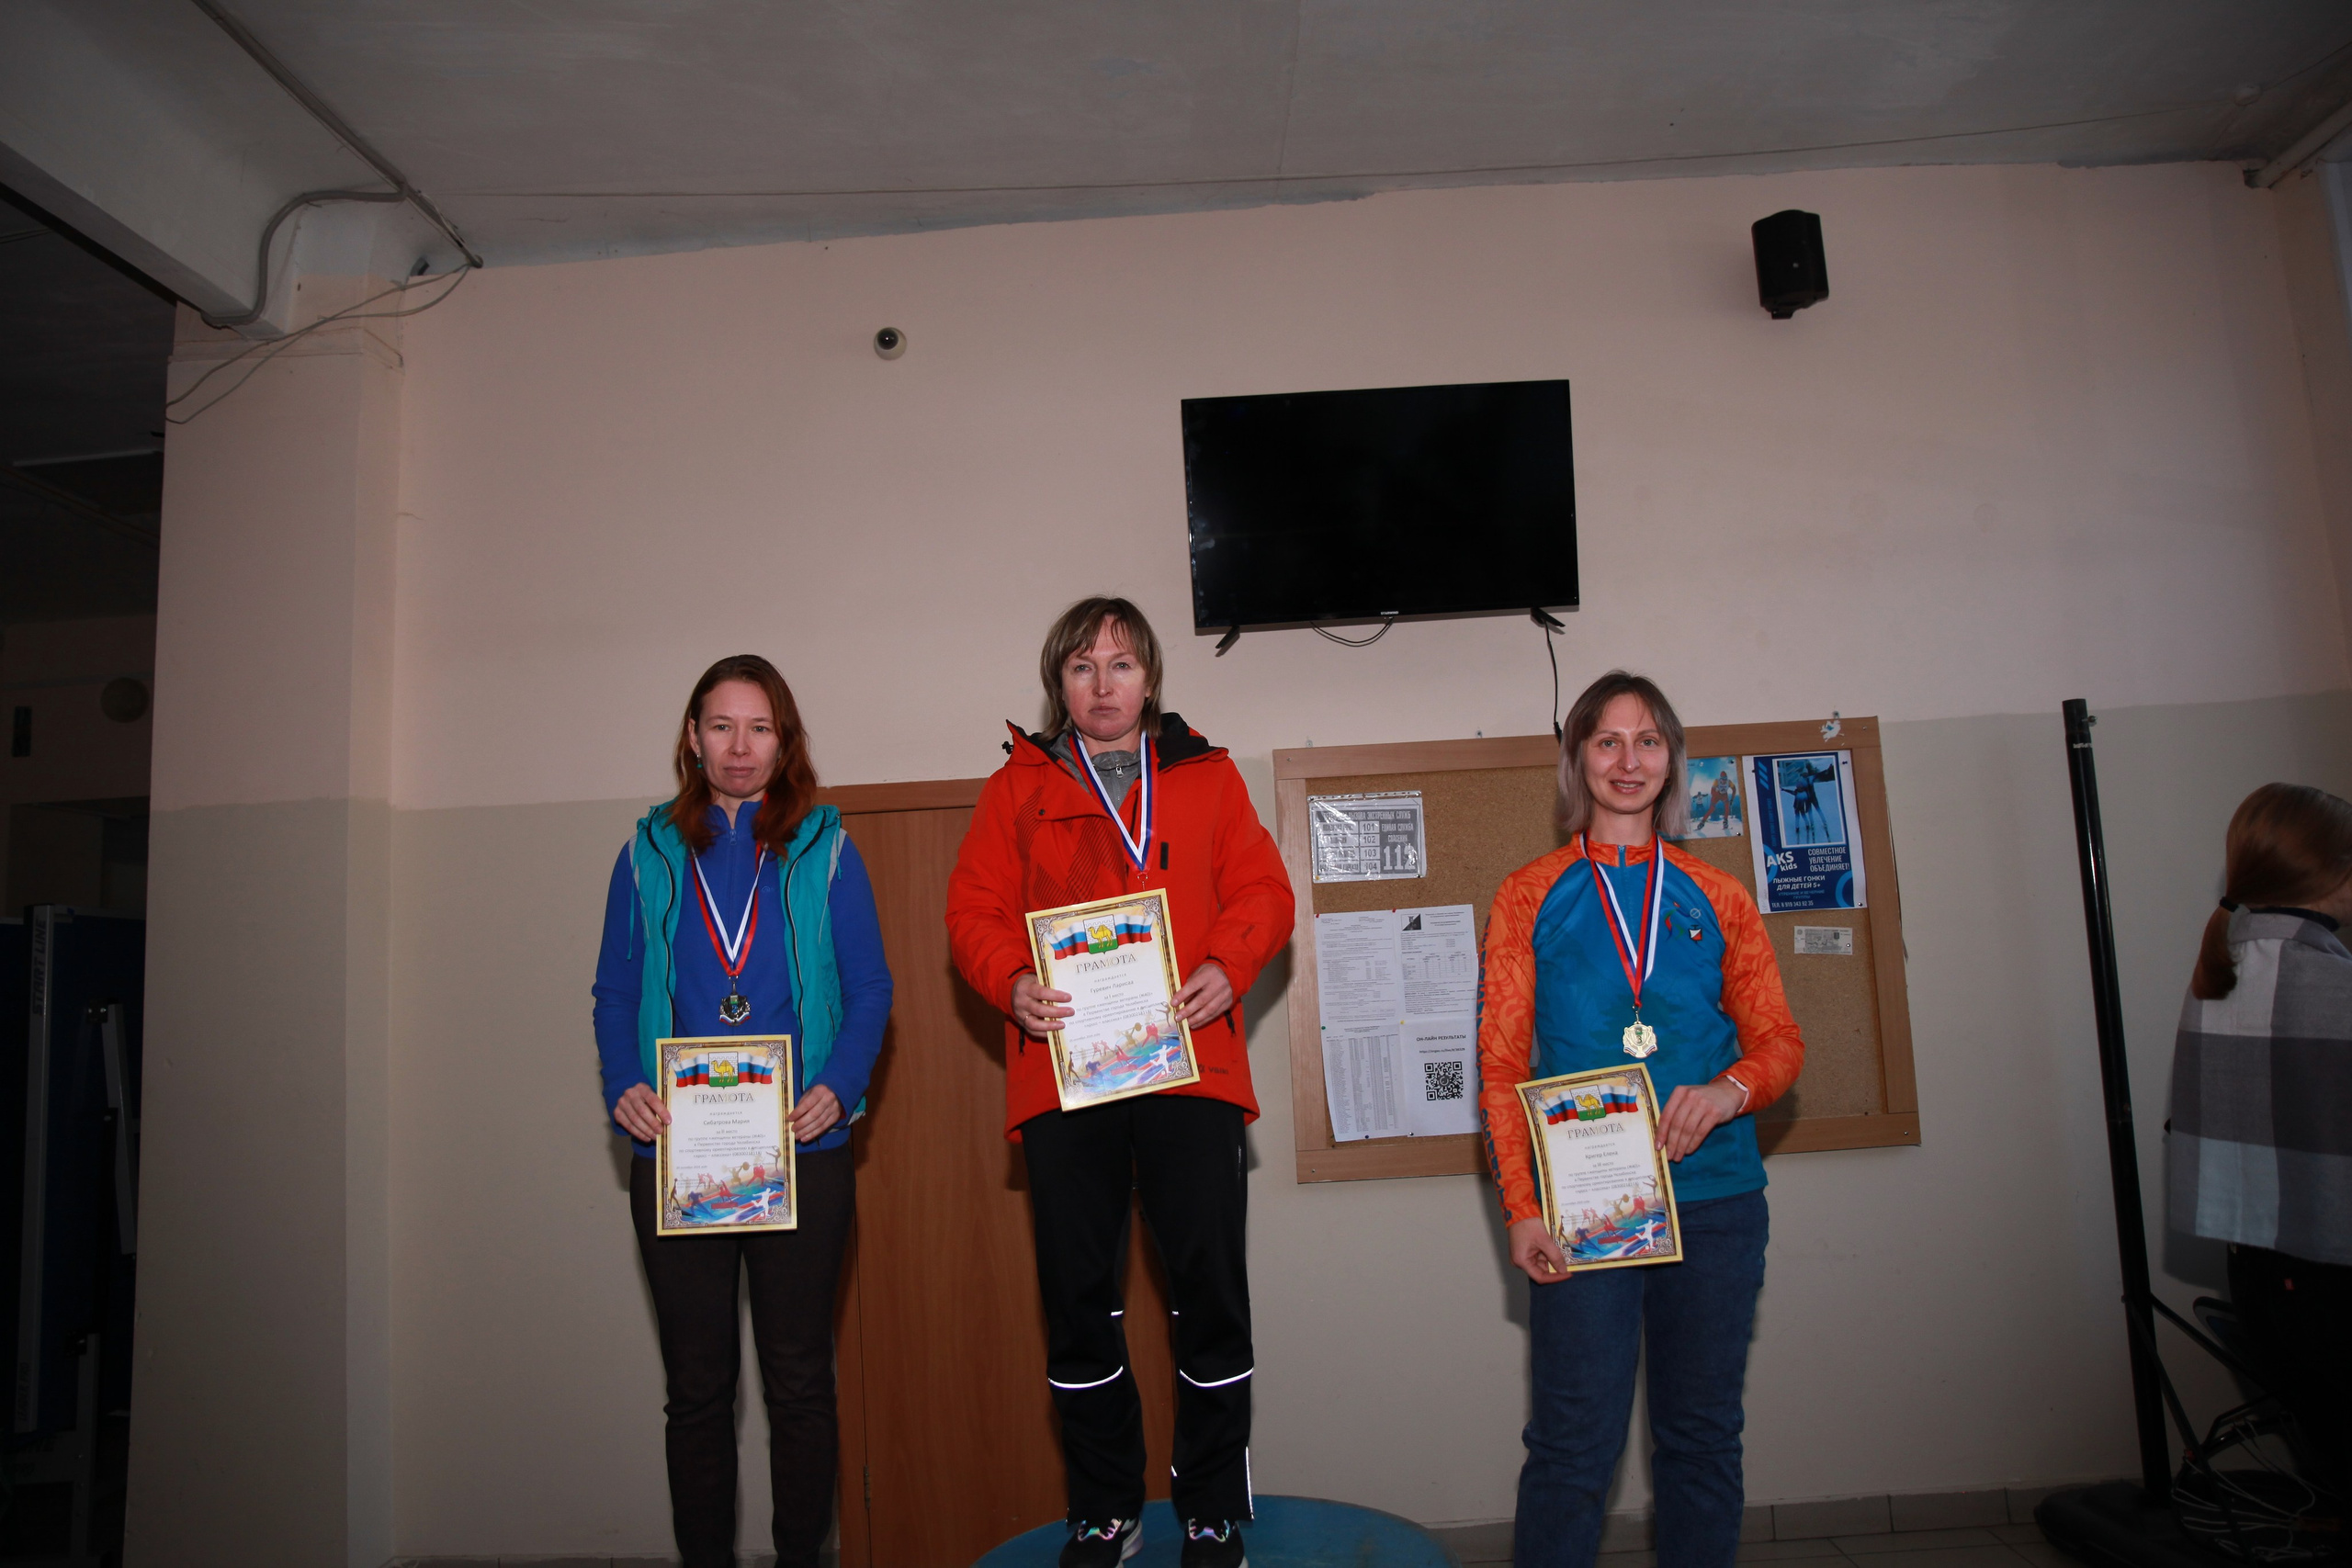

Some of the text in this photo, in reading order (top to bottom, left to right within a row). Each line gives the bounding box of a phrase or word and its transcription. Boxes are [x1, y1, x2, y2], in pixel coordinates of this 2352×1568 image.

[1383, 843, 1416, 870] 112
[1808, 847, 1846, 856] СОВМЕСТНОЕ
[1766, 851, 1794, 868] AKS
[1809, 855, 1842, 864] УВЛЕЧЕНИЕ
[1365, 862, 1377, 871] 104
[1780, 863, 1797, 872] kids
[1810, 863, 1850, 872] ОБЪЕДИНЯЕТ!
[1791, 882, 1812, 890] ДЕТЕЙ
[32, 918, 46, 1016] START LINE
[1076, 954, 1137, 974] ГРАМОТА
[694, 1092, 754, 1103] ГРАМОТА
[1567, 1123, 1624, 1139] ГРАМОТА
